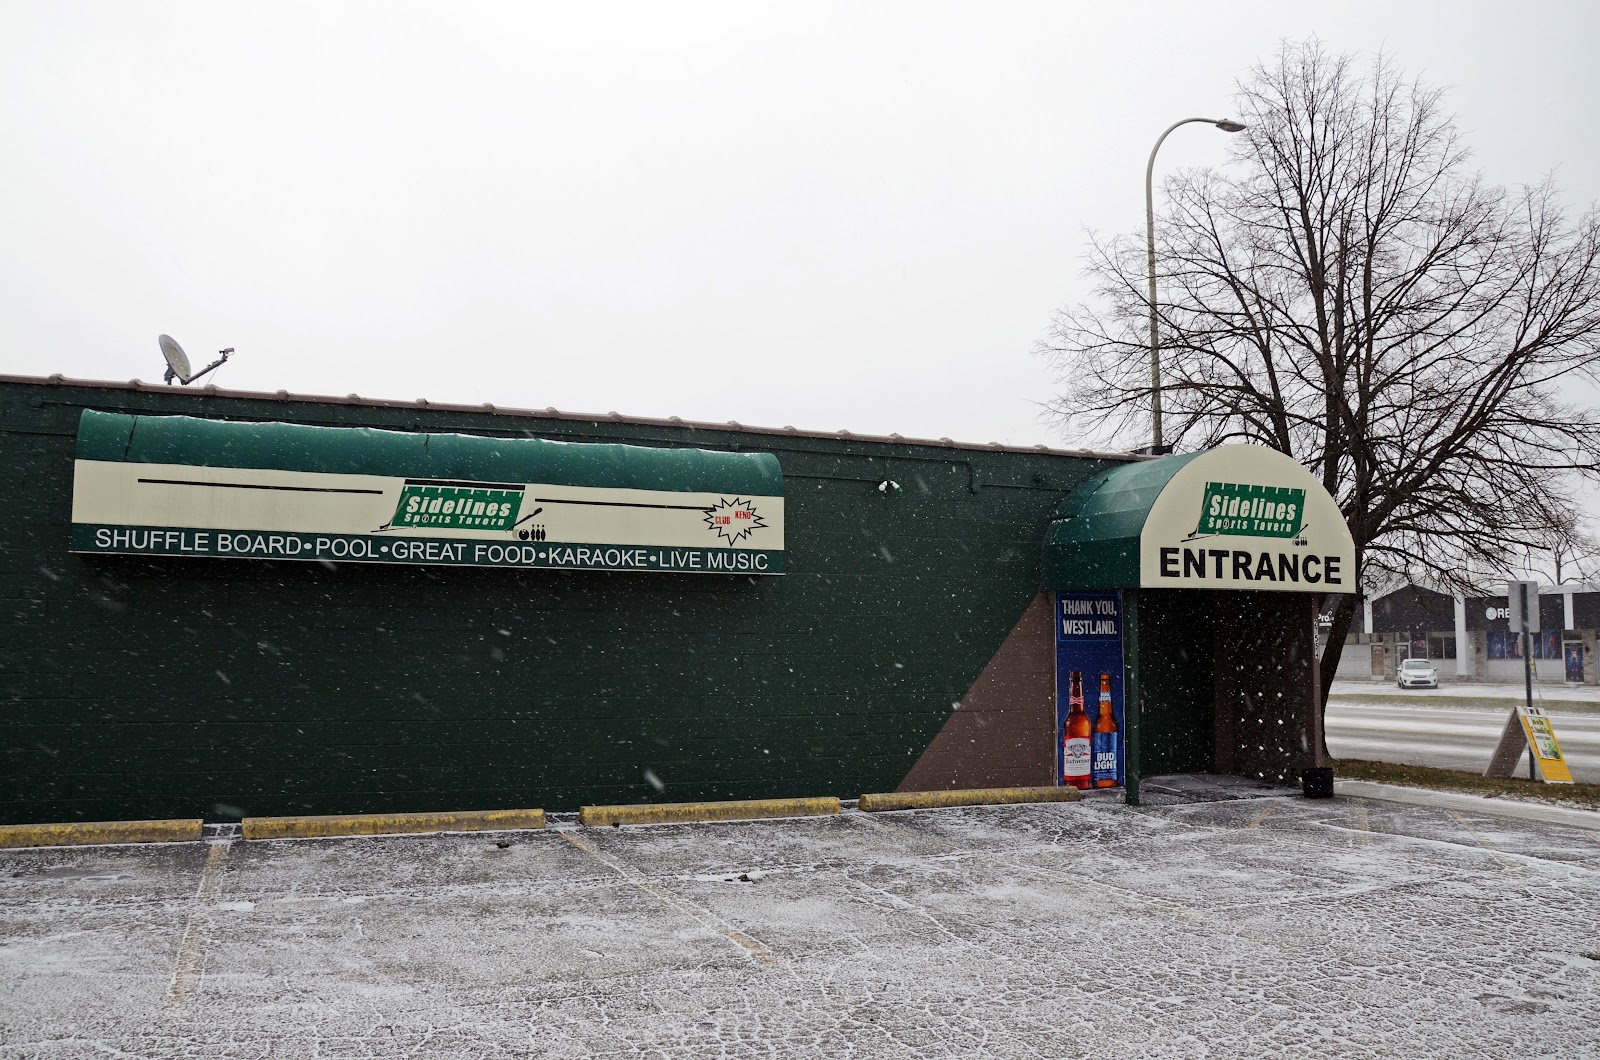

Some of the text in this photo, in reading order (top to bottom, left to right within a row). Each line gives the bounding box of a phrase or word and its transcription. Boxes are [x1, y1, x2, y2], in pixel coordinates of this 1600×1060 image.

[406, 495, 512, 517] Sidelines
[1209, 494, 1297, 521] Sidelines
[404, 513, 505, 526] Sports Tavern
[715, 510, 751, 525] CLUB KENO
[1208, 516, 1292, 533] Sports Tavern
[95, 528, 769, 570] SHUFFLE BOARD POOL GREAT FOOD KARAOKE LIVE MUSIC
[1160, 546, 1342, 585] ENTRANCE
[1061, 599, 1117, 616] THANK YOU,
[1062, 618, 1118, 635] WESTLAND.
[1096, 752, 1115, 762] BUD
[1094, 761, 1118, 771] LIGHT
